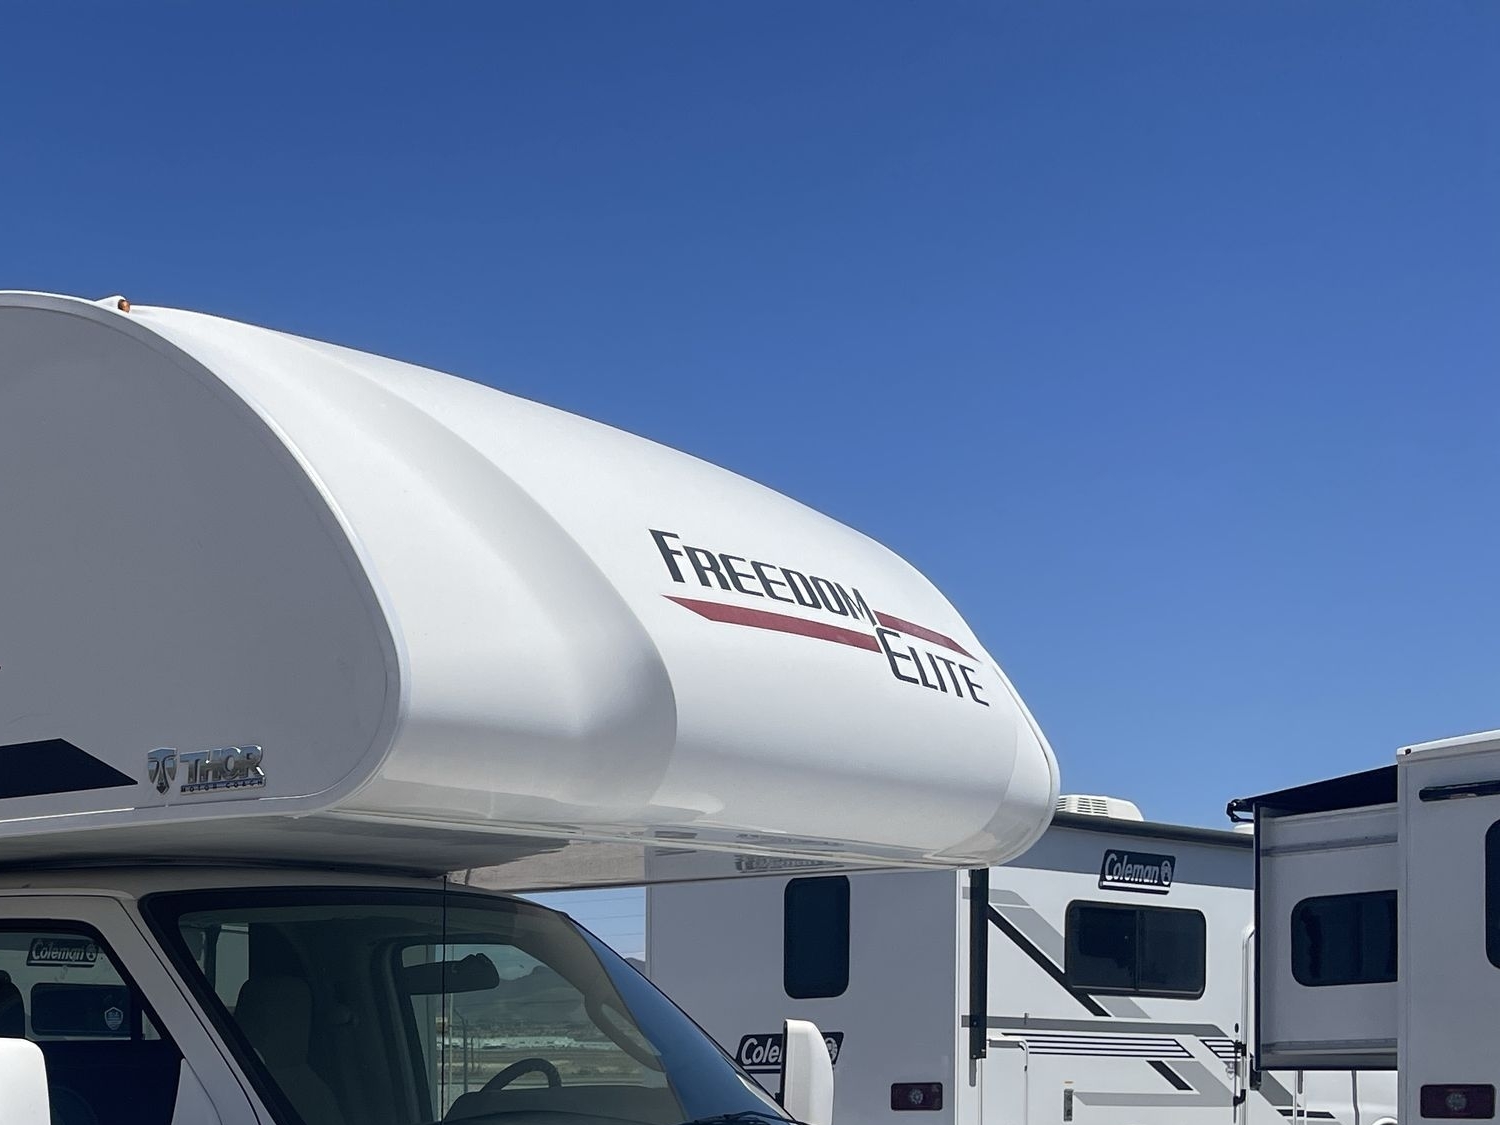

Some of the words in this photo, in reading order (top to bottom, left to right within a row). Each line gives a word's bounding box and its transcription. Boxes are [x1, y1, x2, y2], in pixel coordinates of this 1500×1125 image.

[648, 528, 878, 627] FREEDOM
[876, 626, 991, 708] ELITE
[180, 745, 265, 784] THOR
[1105, 853, 1160, 884] Coleman
[32, 941, 85, 960] Coleman
[741, 1037, 783, 1065] Cole
